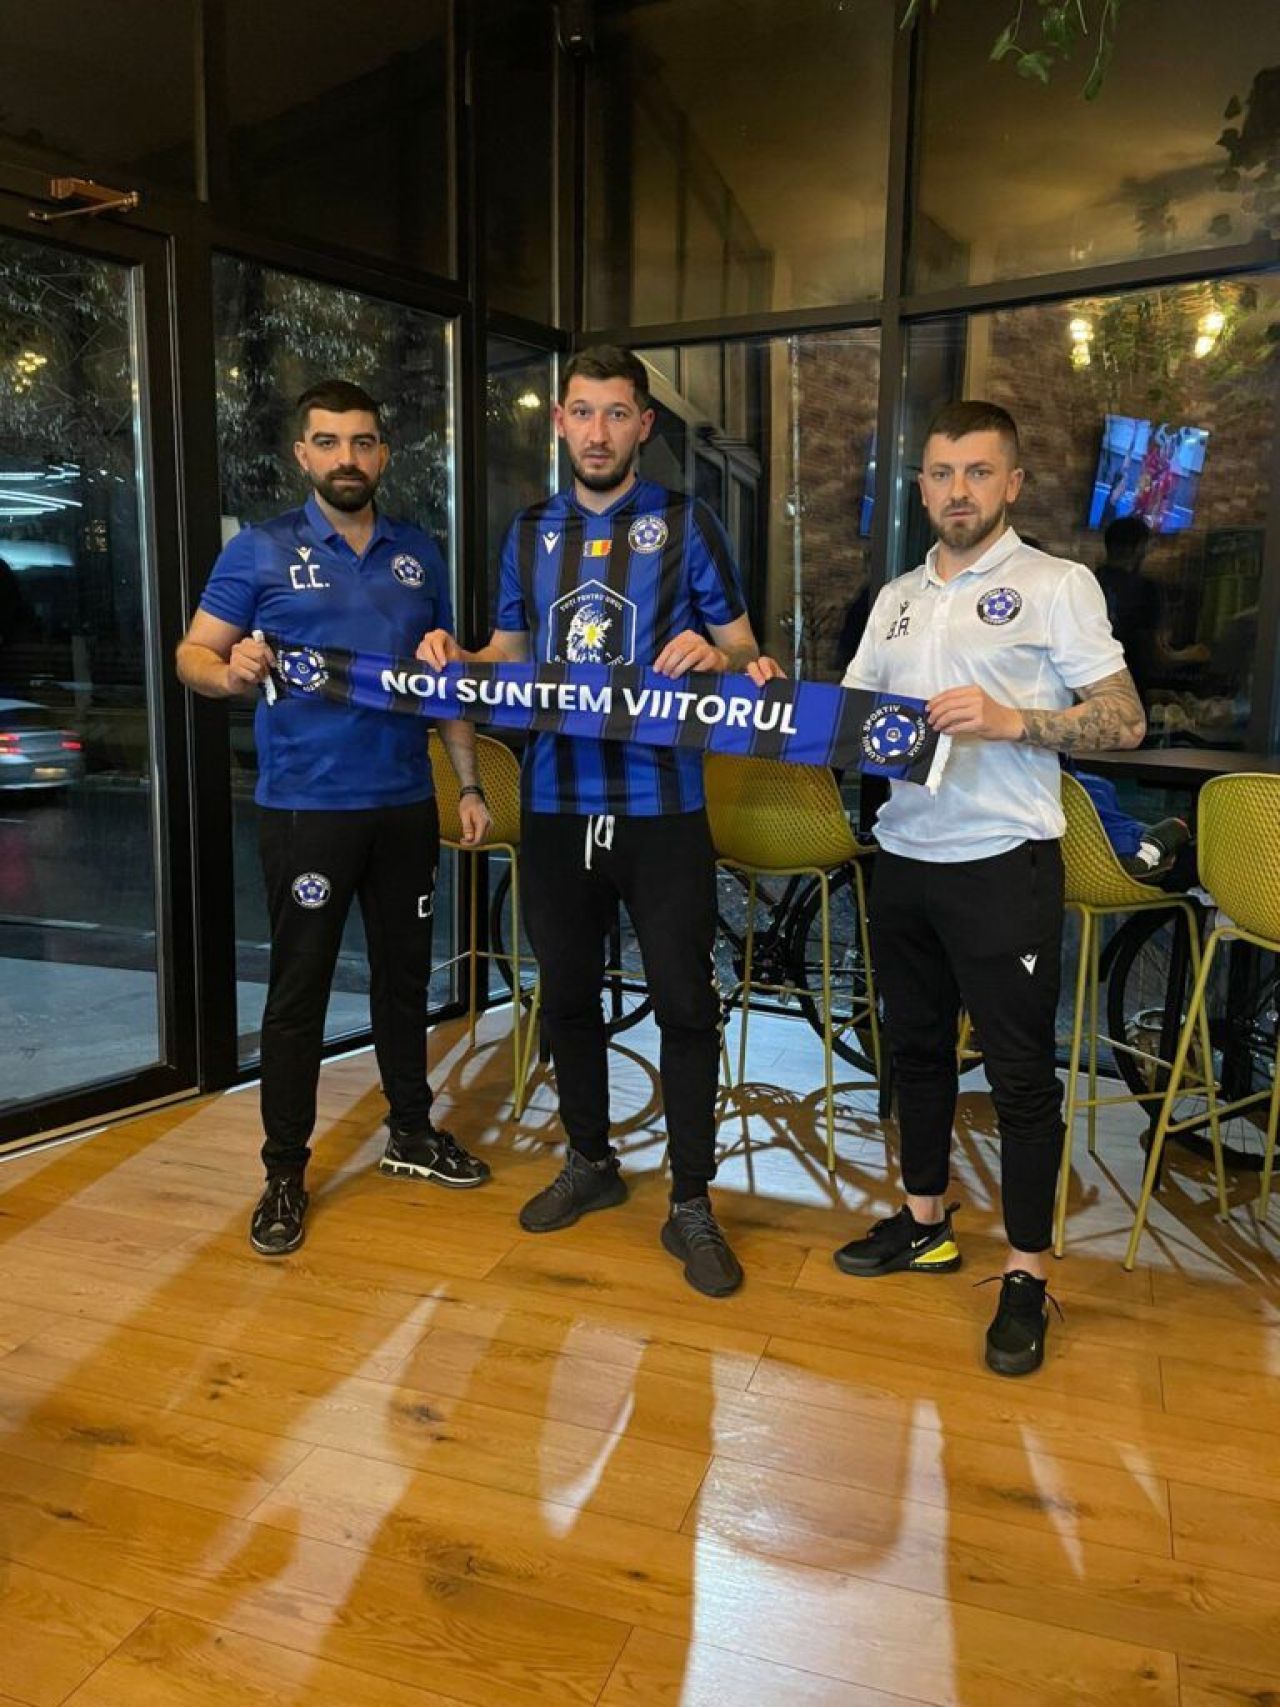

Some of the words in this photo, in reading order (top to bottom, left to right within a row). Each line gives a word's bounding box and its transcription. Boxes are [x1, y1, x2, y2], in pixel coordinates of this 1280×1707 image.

[289, 564, 330, 590] C.C.
[381, 669, 446, 699] NOI
[456, 678, 612, 714] SUNTEM
[623, 688, 797, 734] VIITORUL
[863, 704, 901, 732] SPORTIV
